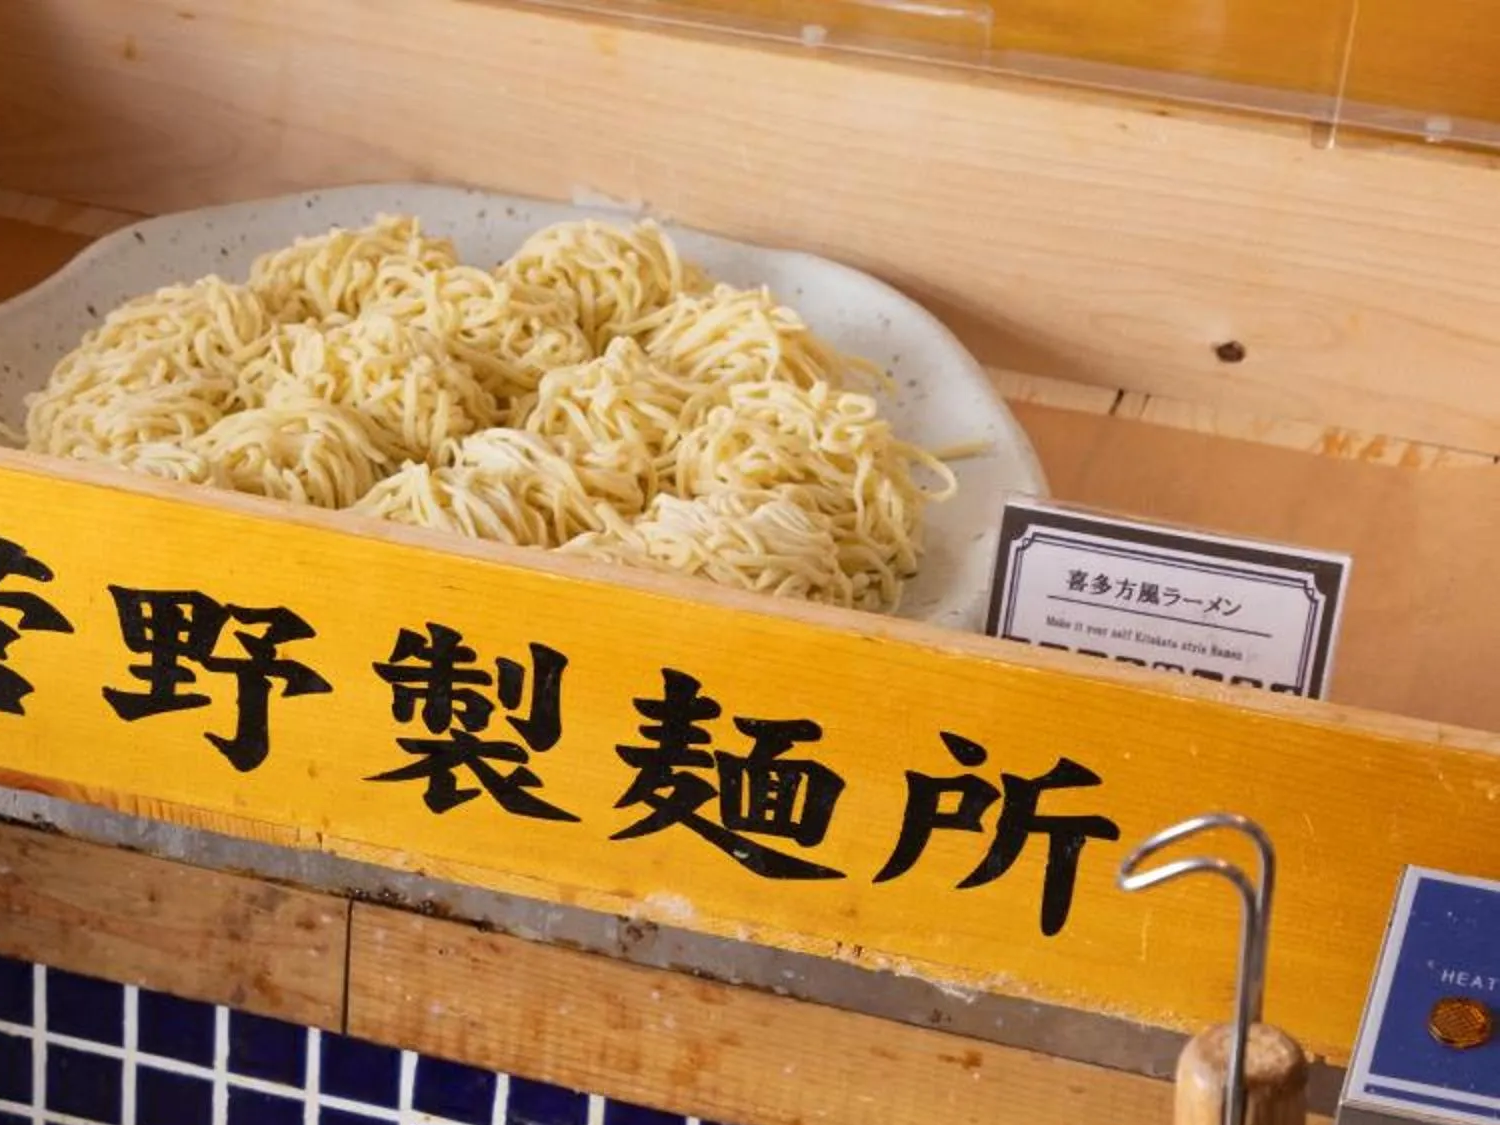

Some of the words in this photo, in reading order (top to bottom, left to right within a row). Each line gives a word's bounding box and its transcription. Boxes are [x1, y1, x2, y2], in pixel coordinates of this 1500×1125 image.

[1066, 568, 1242, 617] 喜多方風ラーメン
[1441, 969, 1499, 991] HEAT
